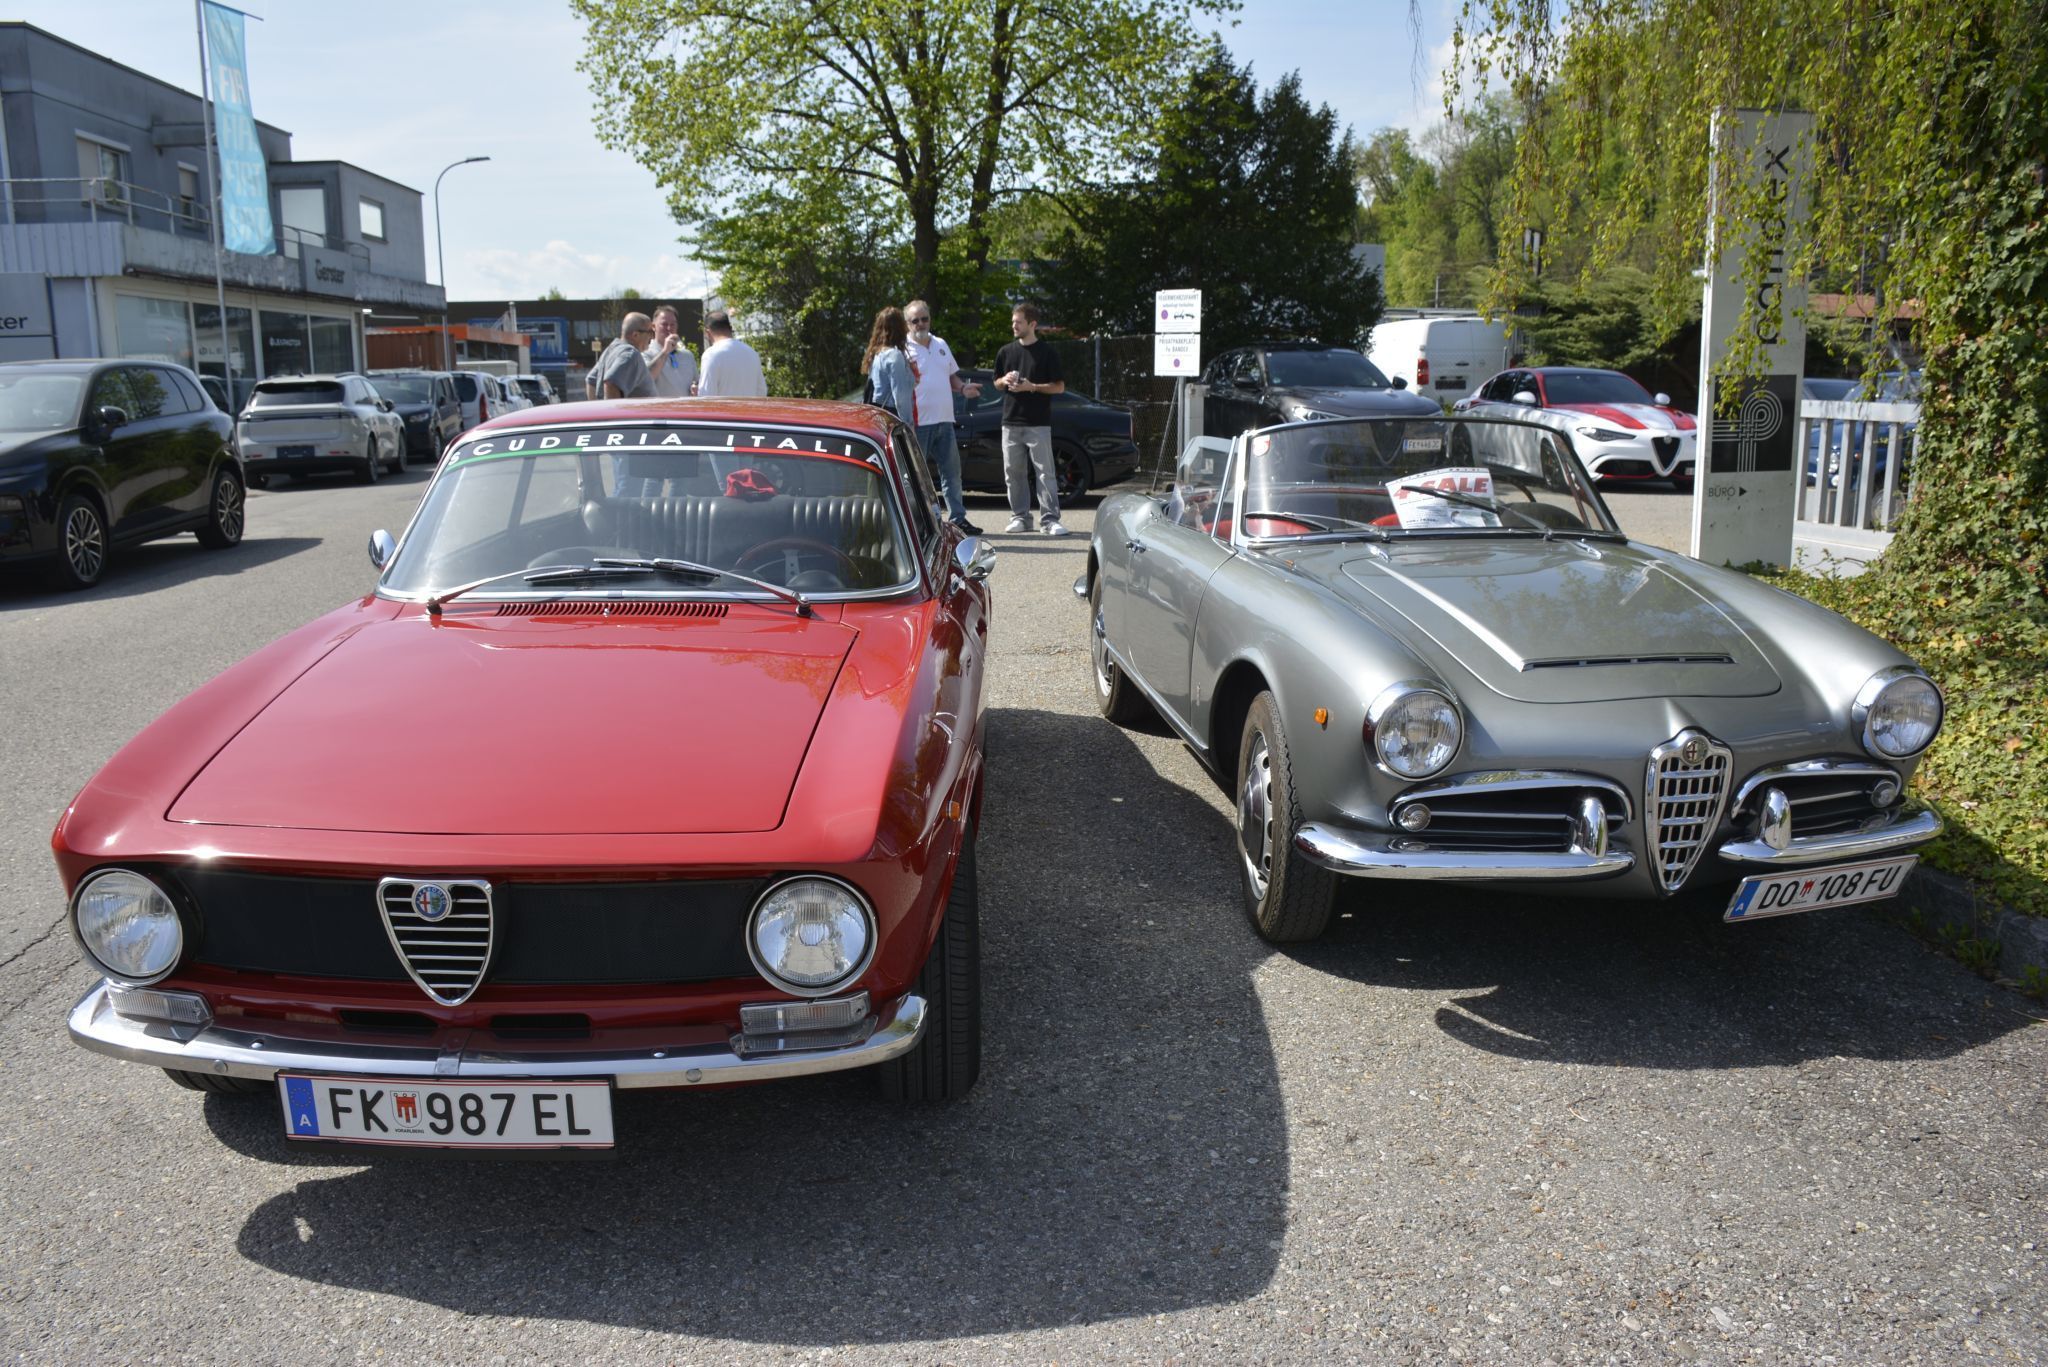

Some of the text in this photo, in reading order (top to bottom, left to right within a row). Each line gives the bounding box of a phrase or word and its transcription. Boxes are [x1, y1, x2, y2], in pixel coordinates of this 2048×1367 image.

[448, 433, 882, 469] SCUDERIA ITALIA
[1708, 485, 1736, 498] BÜRO
[1757, 866, 1902, 910] DO 108 FU
[1735, 904, 1745, 912] A
[299, 1114, 312, 1127] A
[328, 1087, 591, 1136] FK 987 EL
